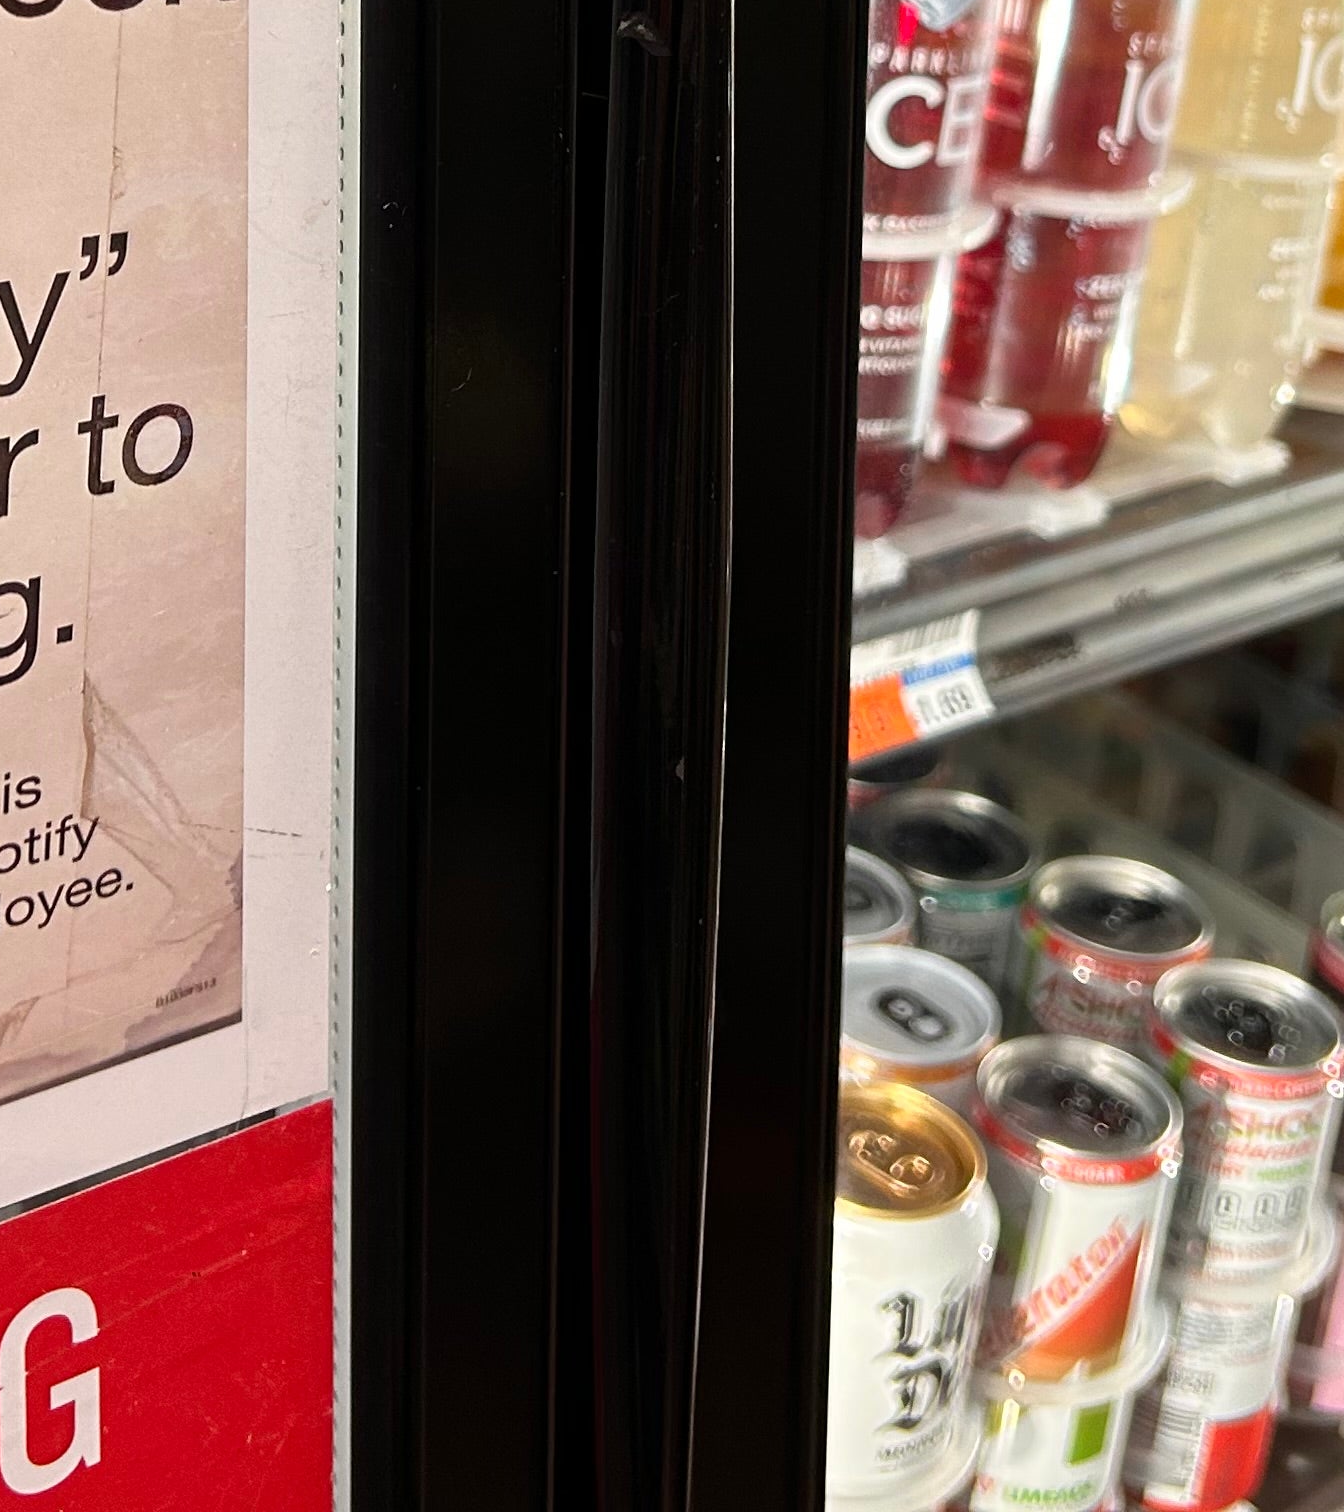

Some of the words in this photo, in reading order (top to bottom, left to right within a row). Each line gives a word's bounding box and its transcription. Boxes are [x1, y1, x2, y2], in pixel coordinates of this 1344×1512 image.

[865, 73, 988, 170] CE
[78, 394, 194, 496] to
[1, 771, 42, 815] is
